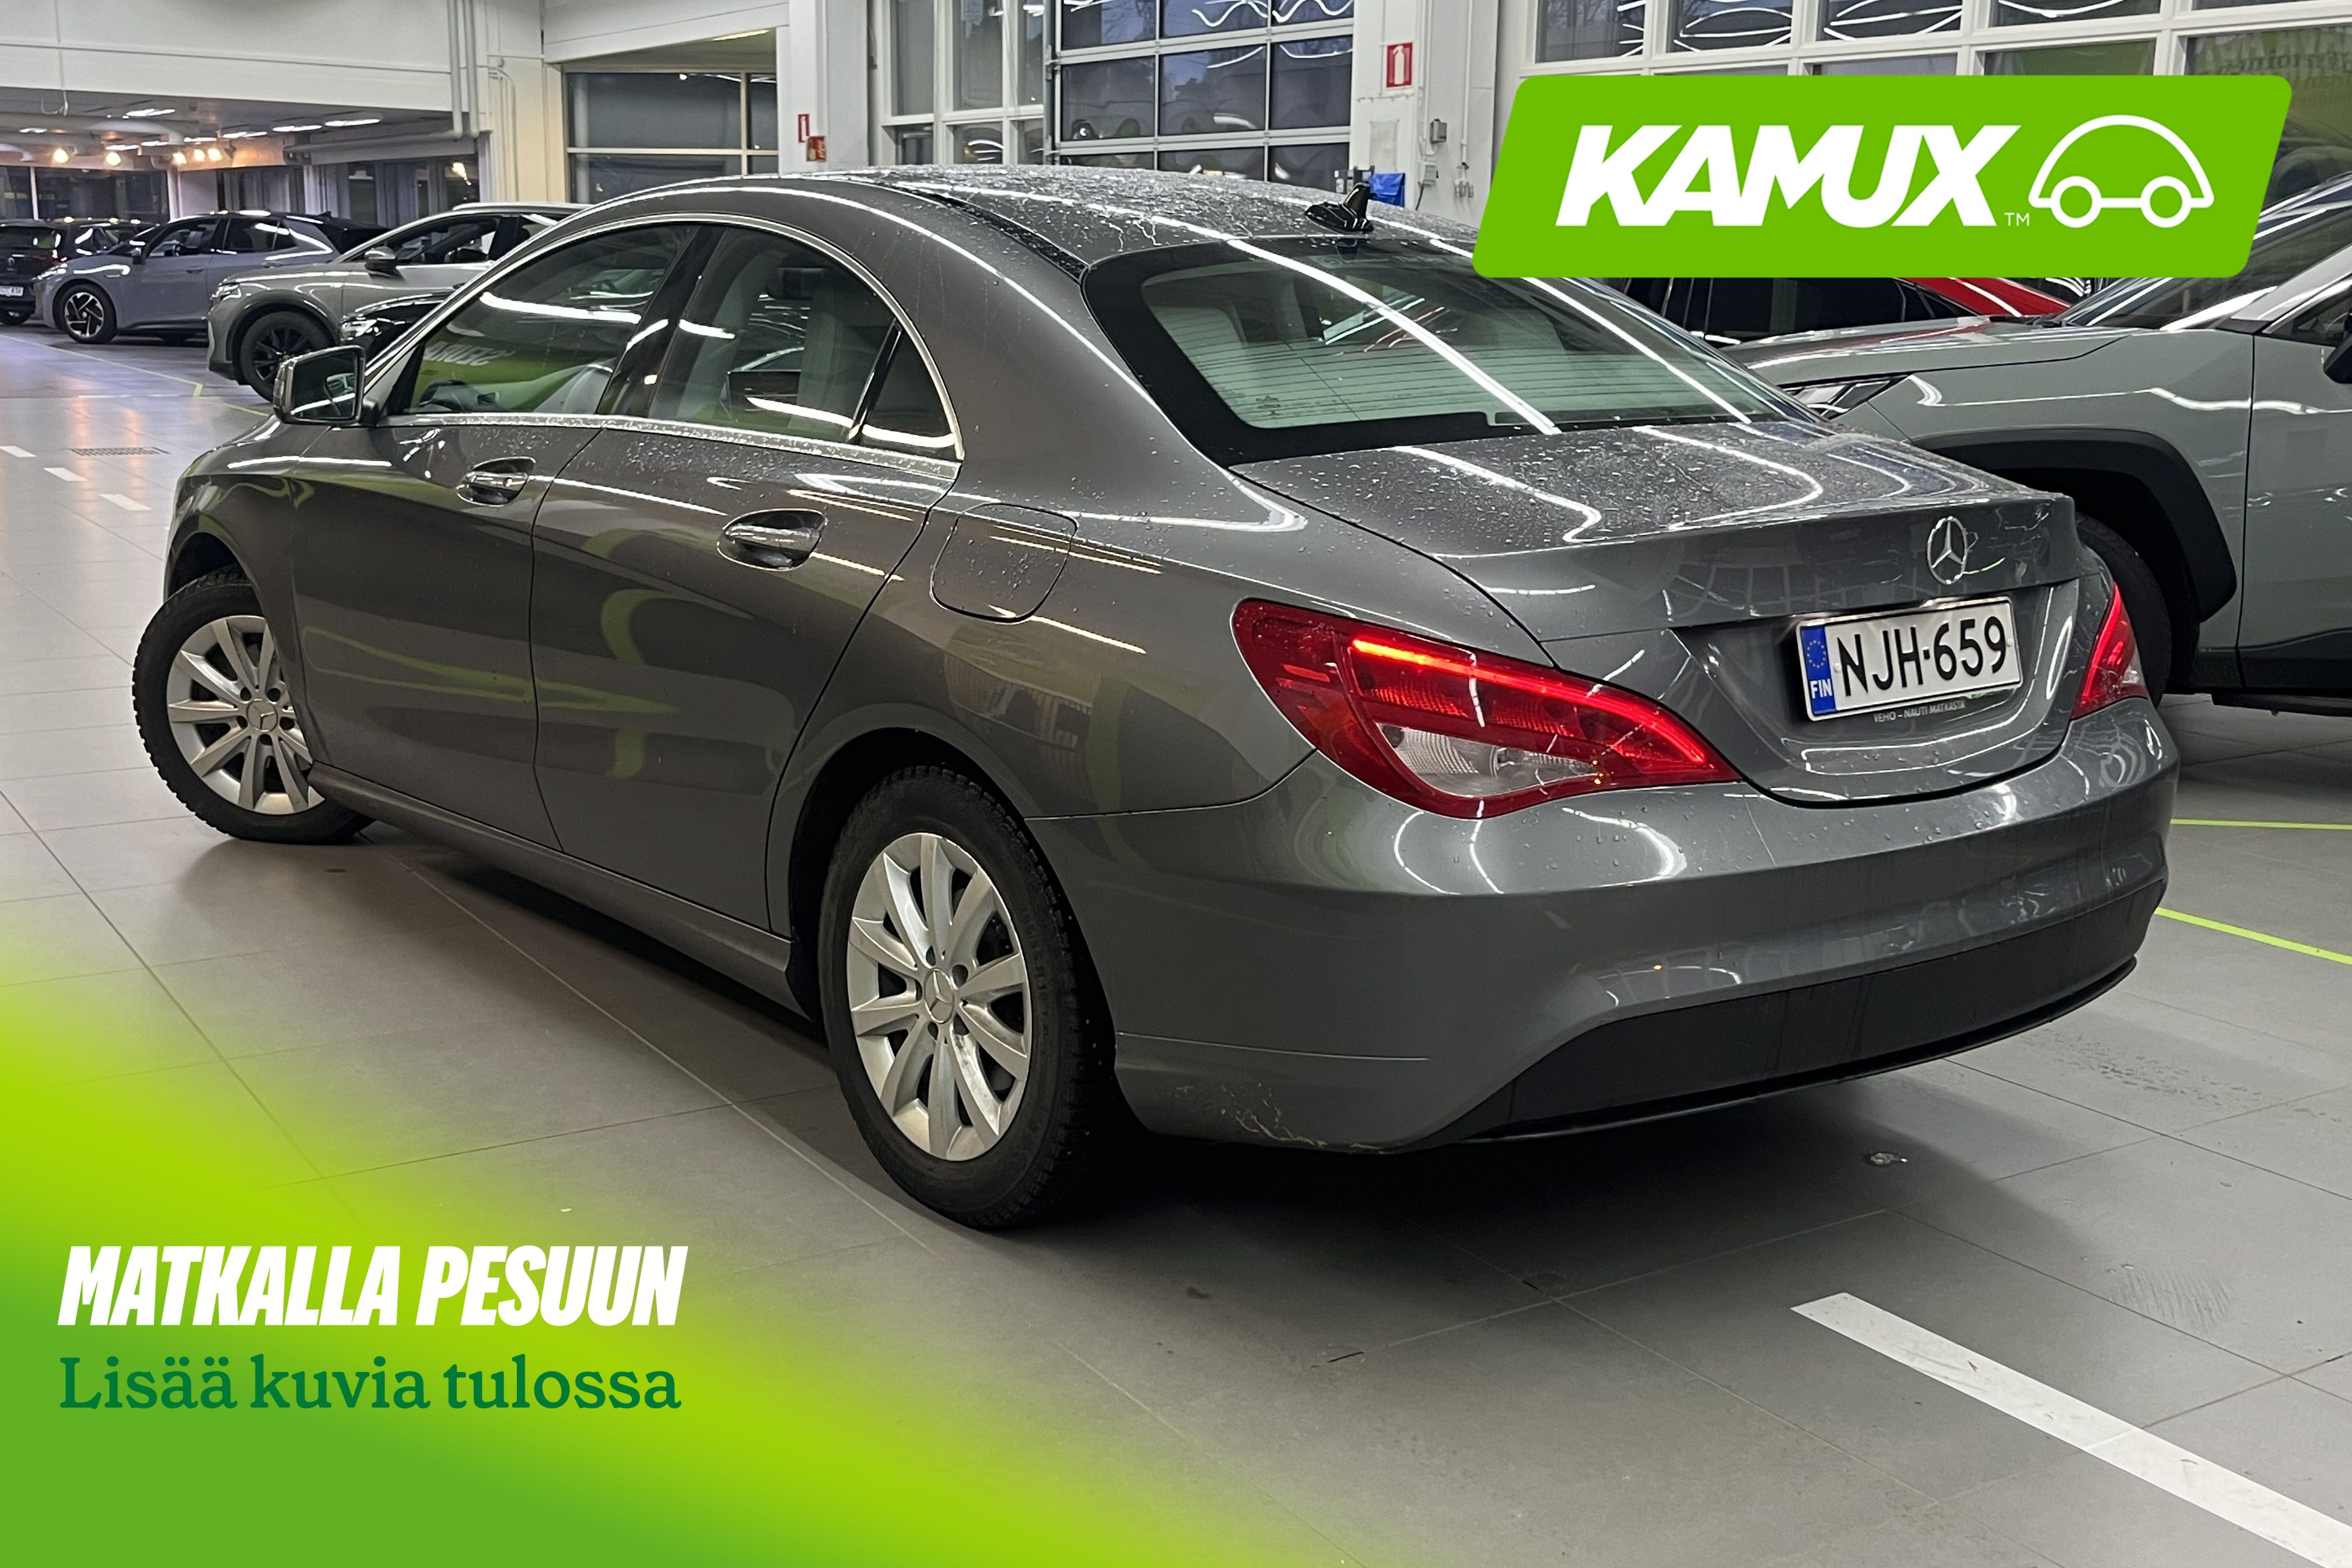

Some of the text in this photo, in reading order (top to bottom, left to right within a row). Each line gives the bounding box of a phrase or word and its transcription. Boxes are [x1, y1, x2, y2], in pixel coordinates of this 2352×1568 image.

[1837, 616, 2007, 696] NJH-659
[1810, 678, 1832, 699] FIN
[1873, 711, 1896, 723] VEHO
[1903, 706, 1928, 718] NAUTI
[1929, 701, 1966, 715] MATKASTA
